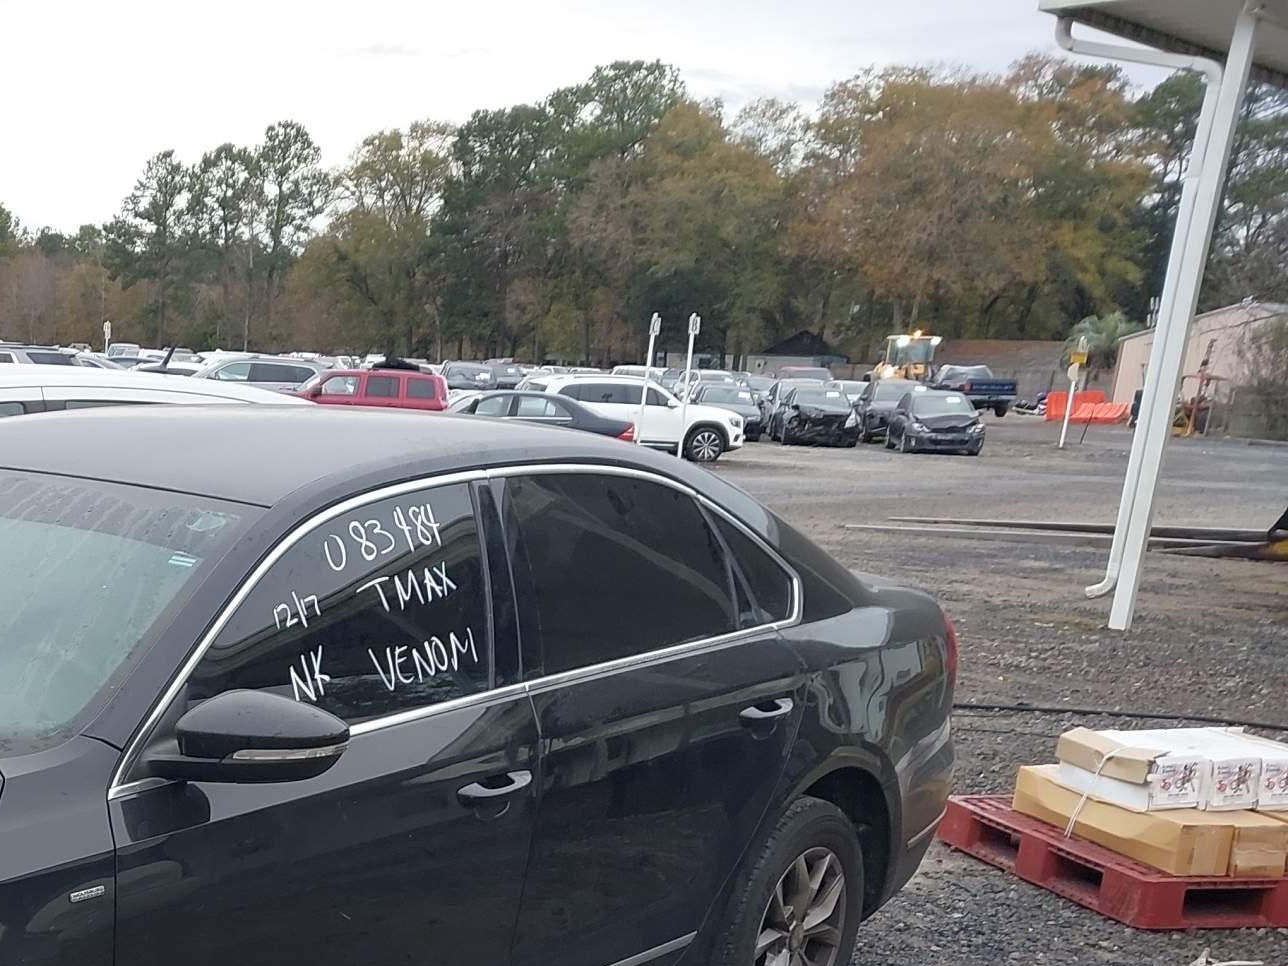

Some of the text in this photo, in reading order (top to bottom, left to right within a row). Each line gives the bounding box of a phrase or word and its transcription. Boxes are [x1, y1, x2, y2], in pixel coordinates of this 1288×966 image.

[273, 560, 458, 631] 12/17 TMAX
[288, 626, 479, 703] NK VENOM
